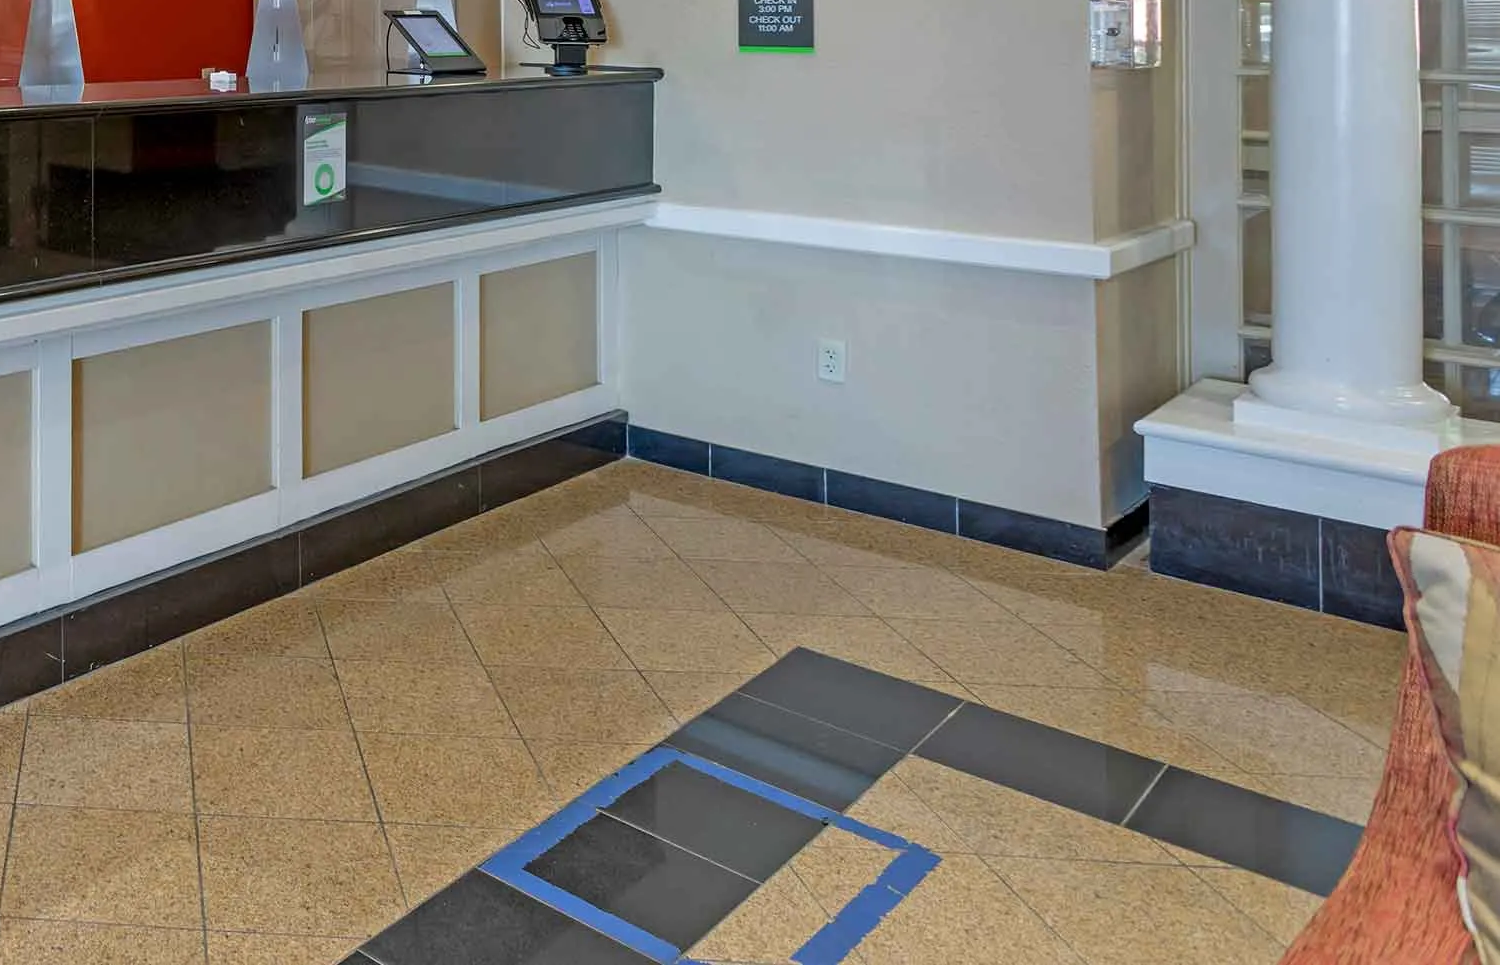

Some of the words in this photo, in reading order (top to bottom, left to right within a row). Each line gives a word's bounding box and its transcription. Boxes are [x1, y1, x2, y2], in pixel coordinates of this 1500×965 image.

[758, 5, 777, 13] 3:00
[778, 5, 793, 13] PM
[748, 15, 781, 24] CHECK
[782, 15, 803, 24] OUT
[758, 24, 778, 33] 11:00
[779, 24, 794, 32] AM
